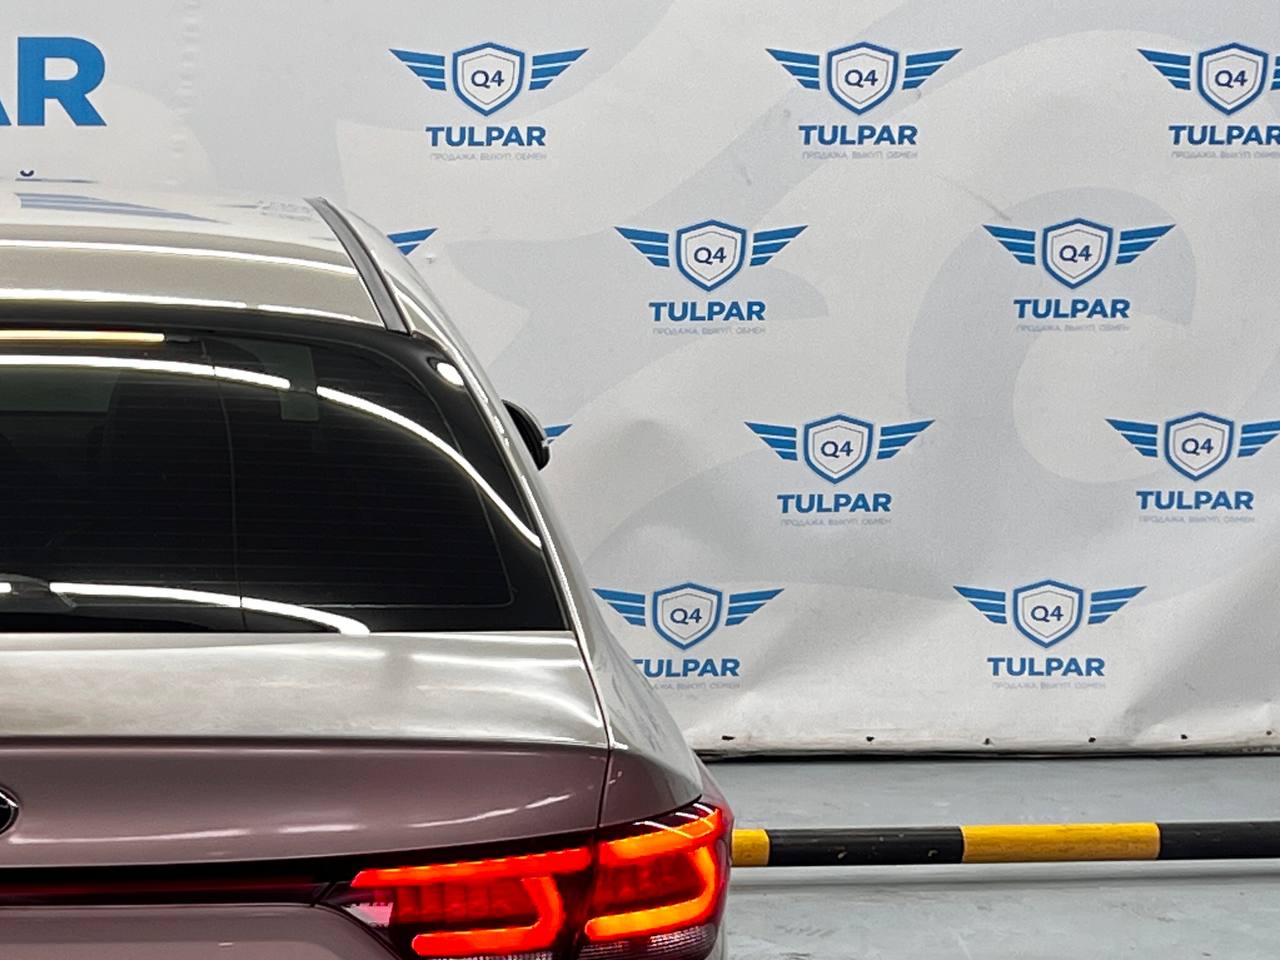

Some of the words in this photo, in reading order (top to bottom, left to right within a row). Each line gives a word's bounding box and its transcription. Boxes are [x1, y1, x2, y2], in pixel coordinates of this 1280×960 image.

[471, 70, 504, 88] Q4
[845, 70, 878, 88] Q4
[1215, 70, 1247, 88] Q4
[426, 126, 546, 147] TULPAR
[799, 124, 918, 146] TULPAR
[694, 247, 726, 265] Q4
[1060, 245, 1092, 263] Q4
[651, 300, 766, 322] TULPAR
[1013, 298, 1131, 320] TULPAR
[821, 441, 853, 458] Q4
[1182, 438, 1213, 455] Q4
[778, 492, 892, 514] TULPAR
[1135, 490, 1255, 511] TULPAR
[670, 608, 702, 625] Q4
[1031, 606, 1063, 622] Q4
[988, 657, 1105, 677] TULPAR
